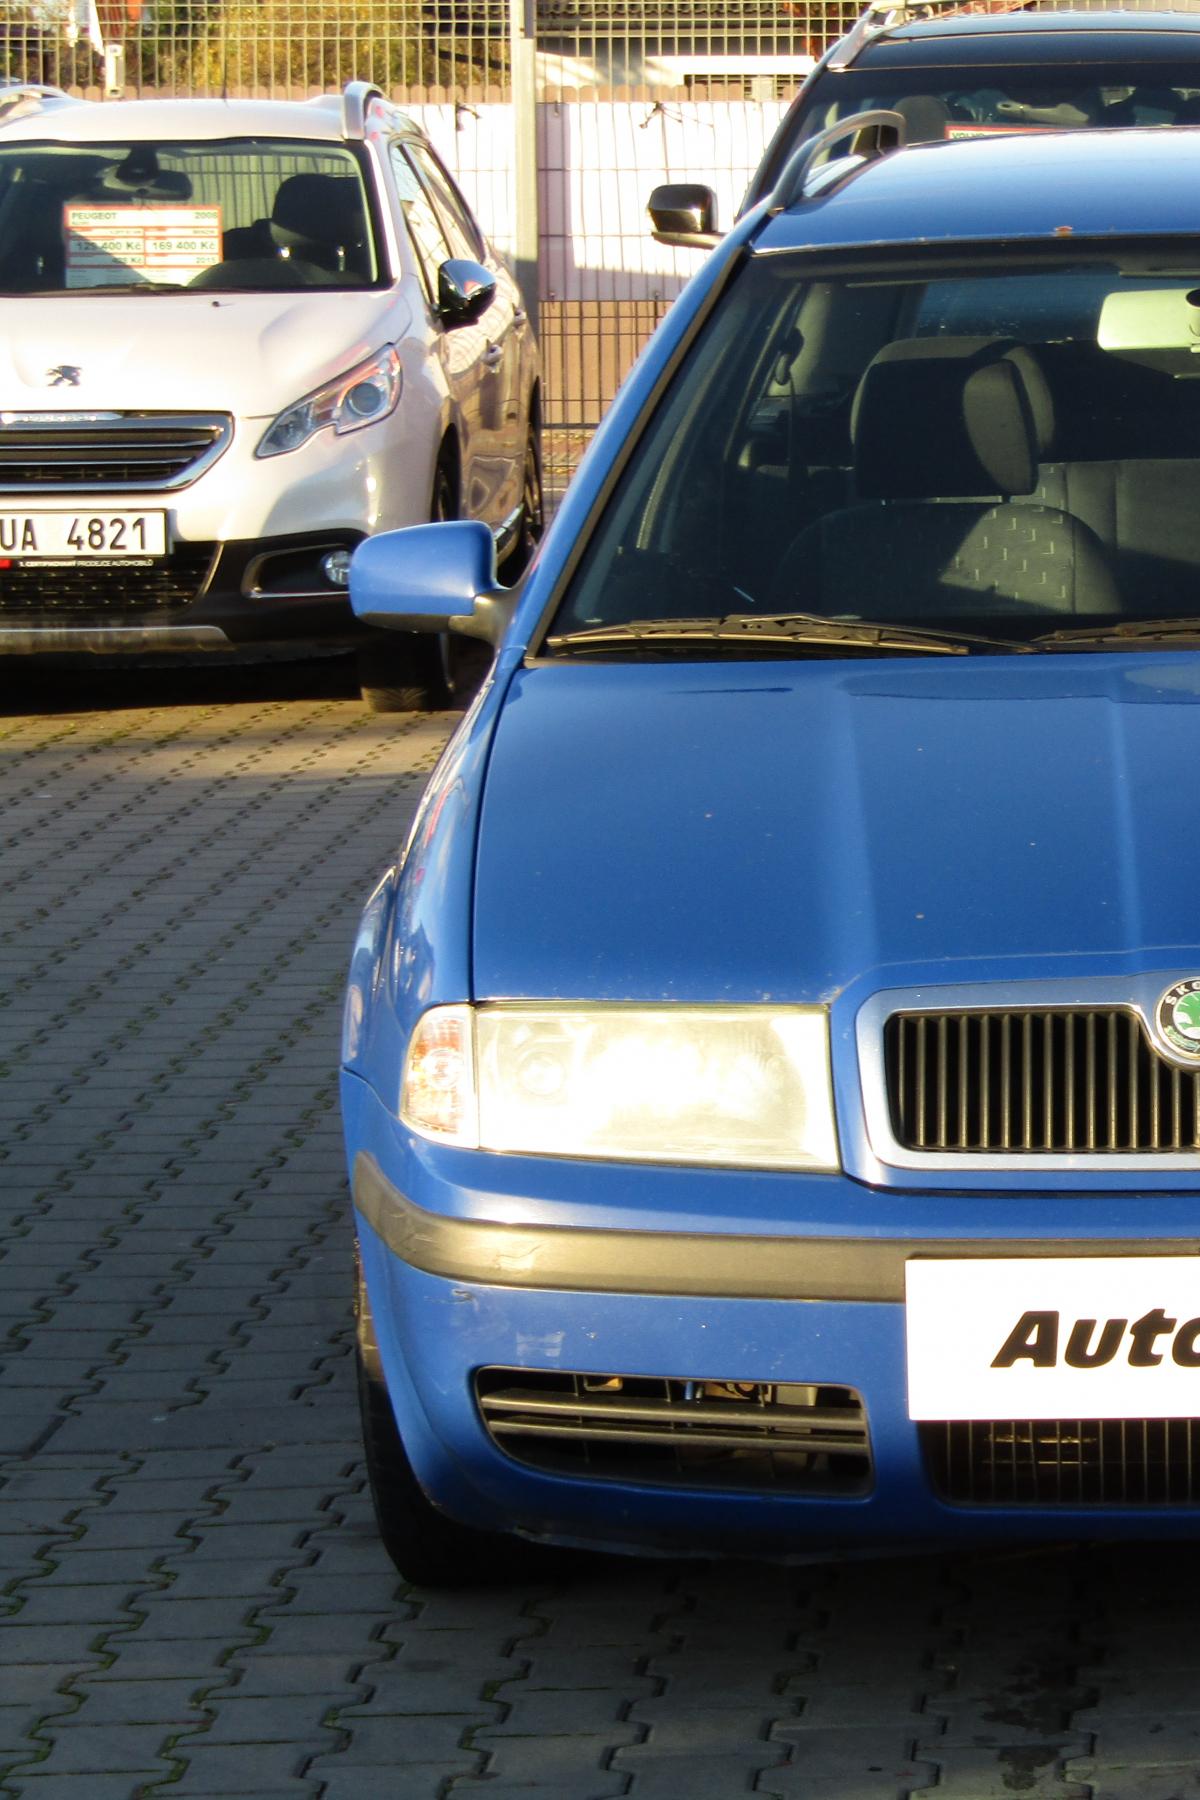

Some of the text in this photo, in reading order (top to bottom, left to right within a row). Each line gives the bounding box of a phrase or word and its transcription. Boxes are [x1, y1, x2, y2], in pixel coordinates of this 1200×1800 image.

[71, 212, 117, 220] PEUGEOT
[126, 241, 142, 250] Kč
[153, 240, 216, 250] 169 400 Kč
[0, 518, 146, 551] UA 4821
